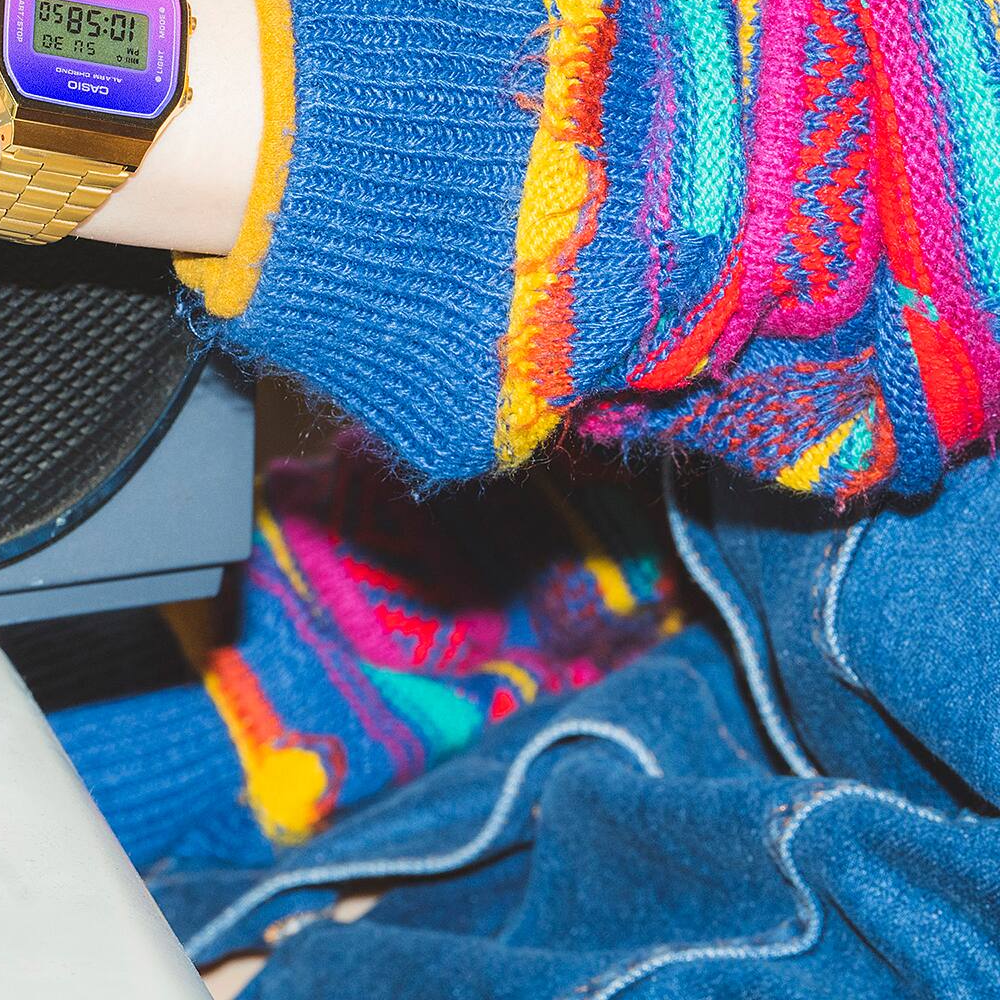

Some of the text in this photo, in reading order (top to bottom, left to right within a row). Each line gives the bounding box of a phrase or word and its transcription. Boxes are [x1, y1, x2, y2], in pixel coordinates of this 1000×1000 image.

[38, 1, 136, 42] 10:58 50
[42, 33, 64, 51] 30
[157, 13, 168, 76] LIGHT MODE
[126, 47, 140, 58] PM
[55, 66, 123, 84] ALARM CHRONO
[67, 79, 110, 96] CASIO
